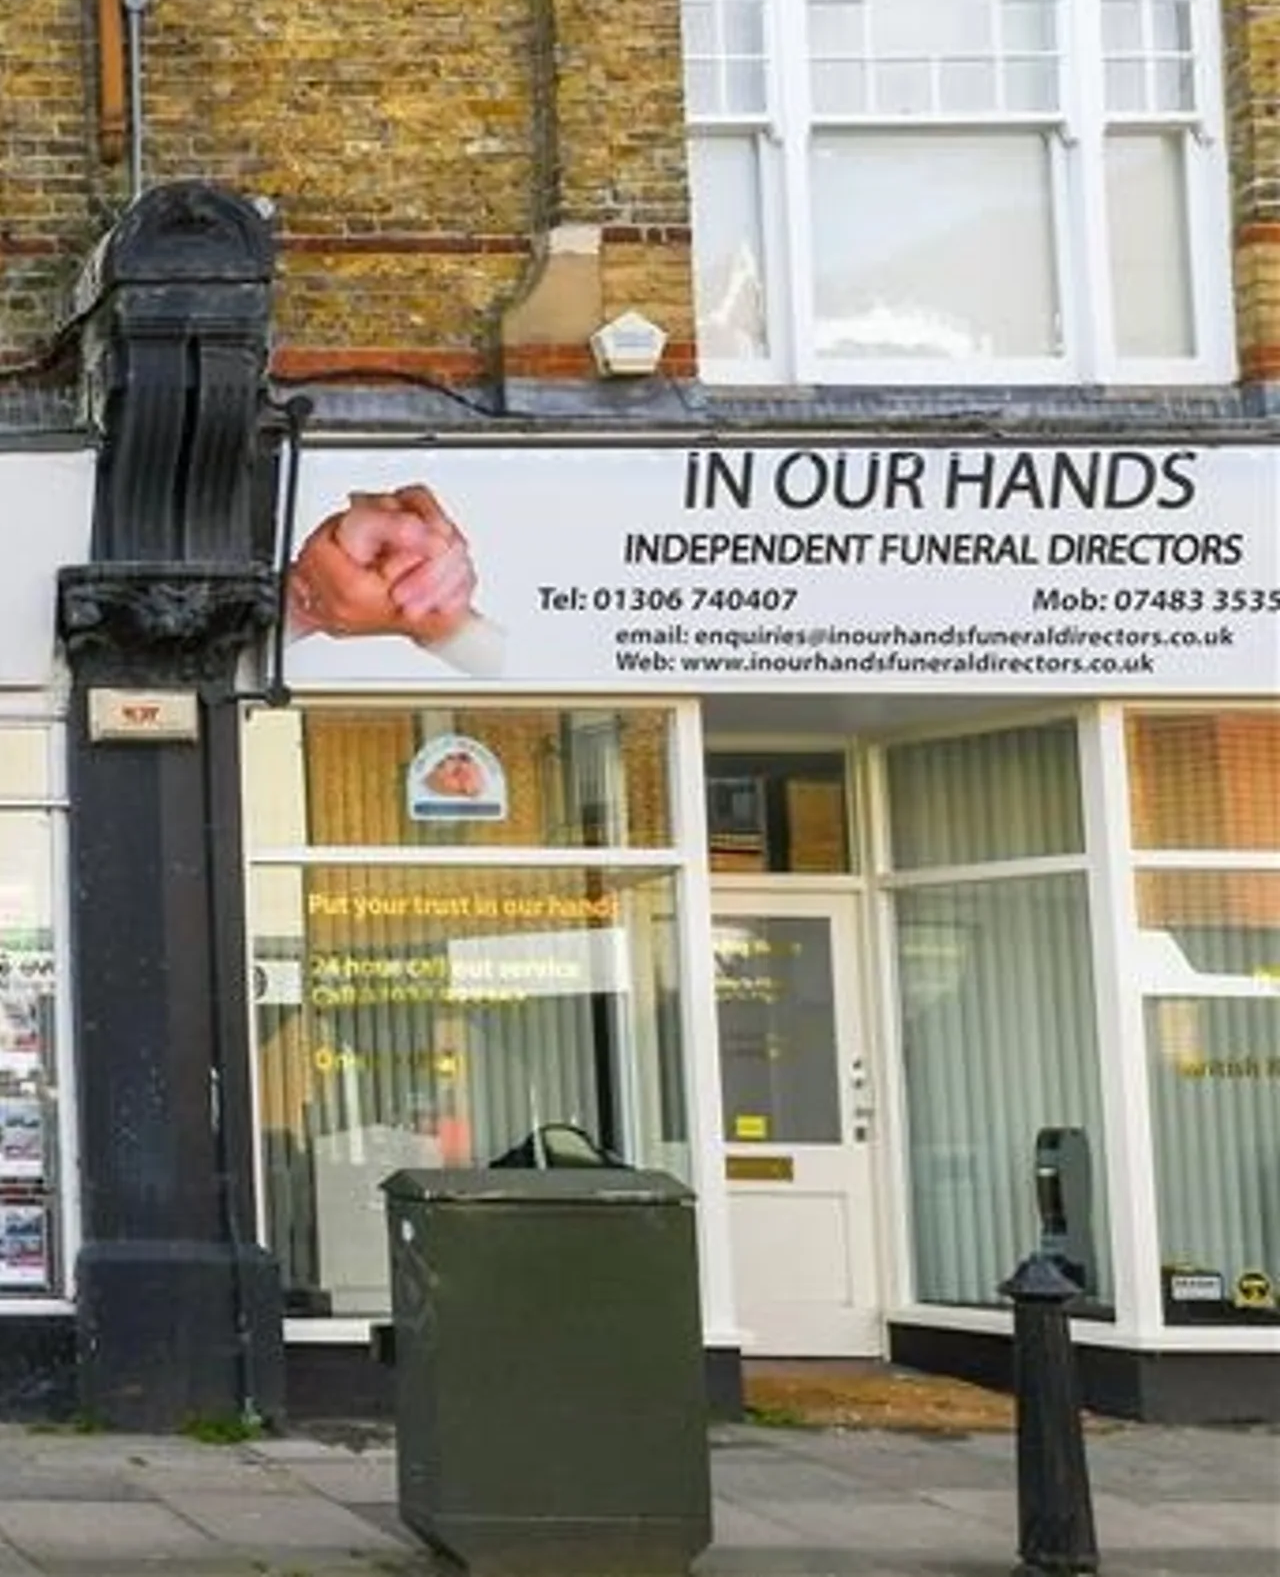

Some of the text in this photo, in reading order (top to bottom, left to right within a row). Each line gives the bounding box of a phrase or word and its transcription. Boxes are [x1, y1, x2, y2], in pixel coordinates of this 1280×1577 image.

[684, 450, 1198, 510] IN OUR HANDS
[624, 533, 1243, 566] INDEPENDENT FUNERAL DIRECTORS
[538, 587, 799, 611] Tel: 01306 740407
[1032, 587, 1107, 612] Mob:
[1114, 588, 1204, 612] 07483
[615, 624, 1235, 649] email: enquiries@inourhandsfuneraldirectors.co.uk
[615, 651, 1155, 673] Web: www.inourhandsfuneraldirectors.co.uk
[308, 893, 348, 914] Put
[354, 897, 407, 919] your
[412, 894, 470, 915] trust
[503, 897, 544, 915] our
